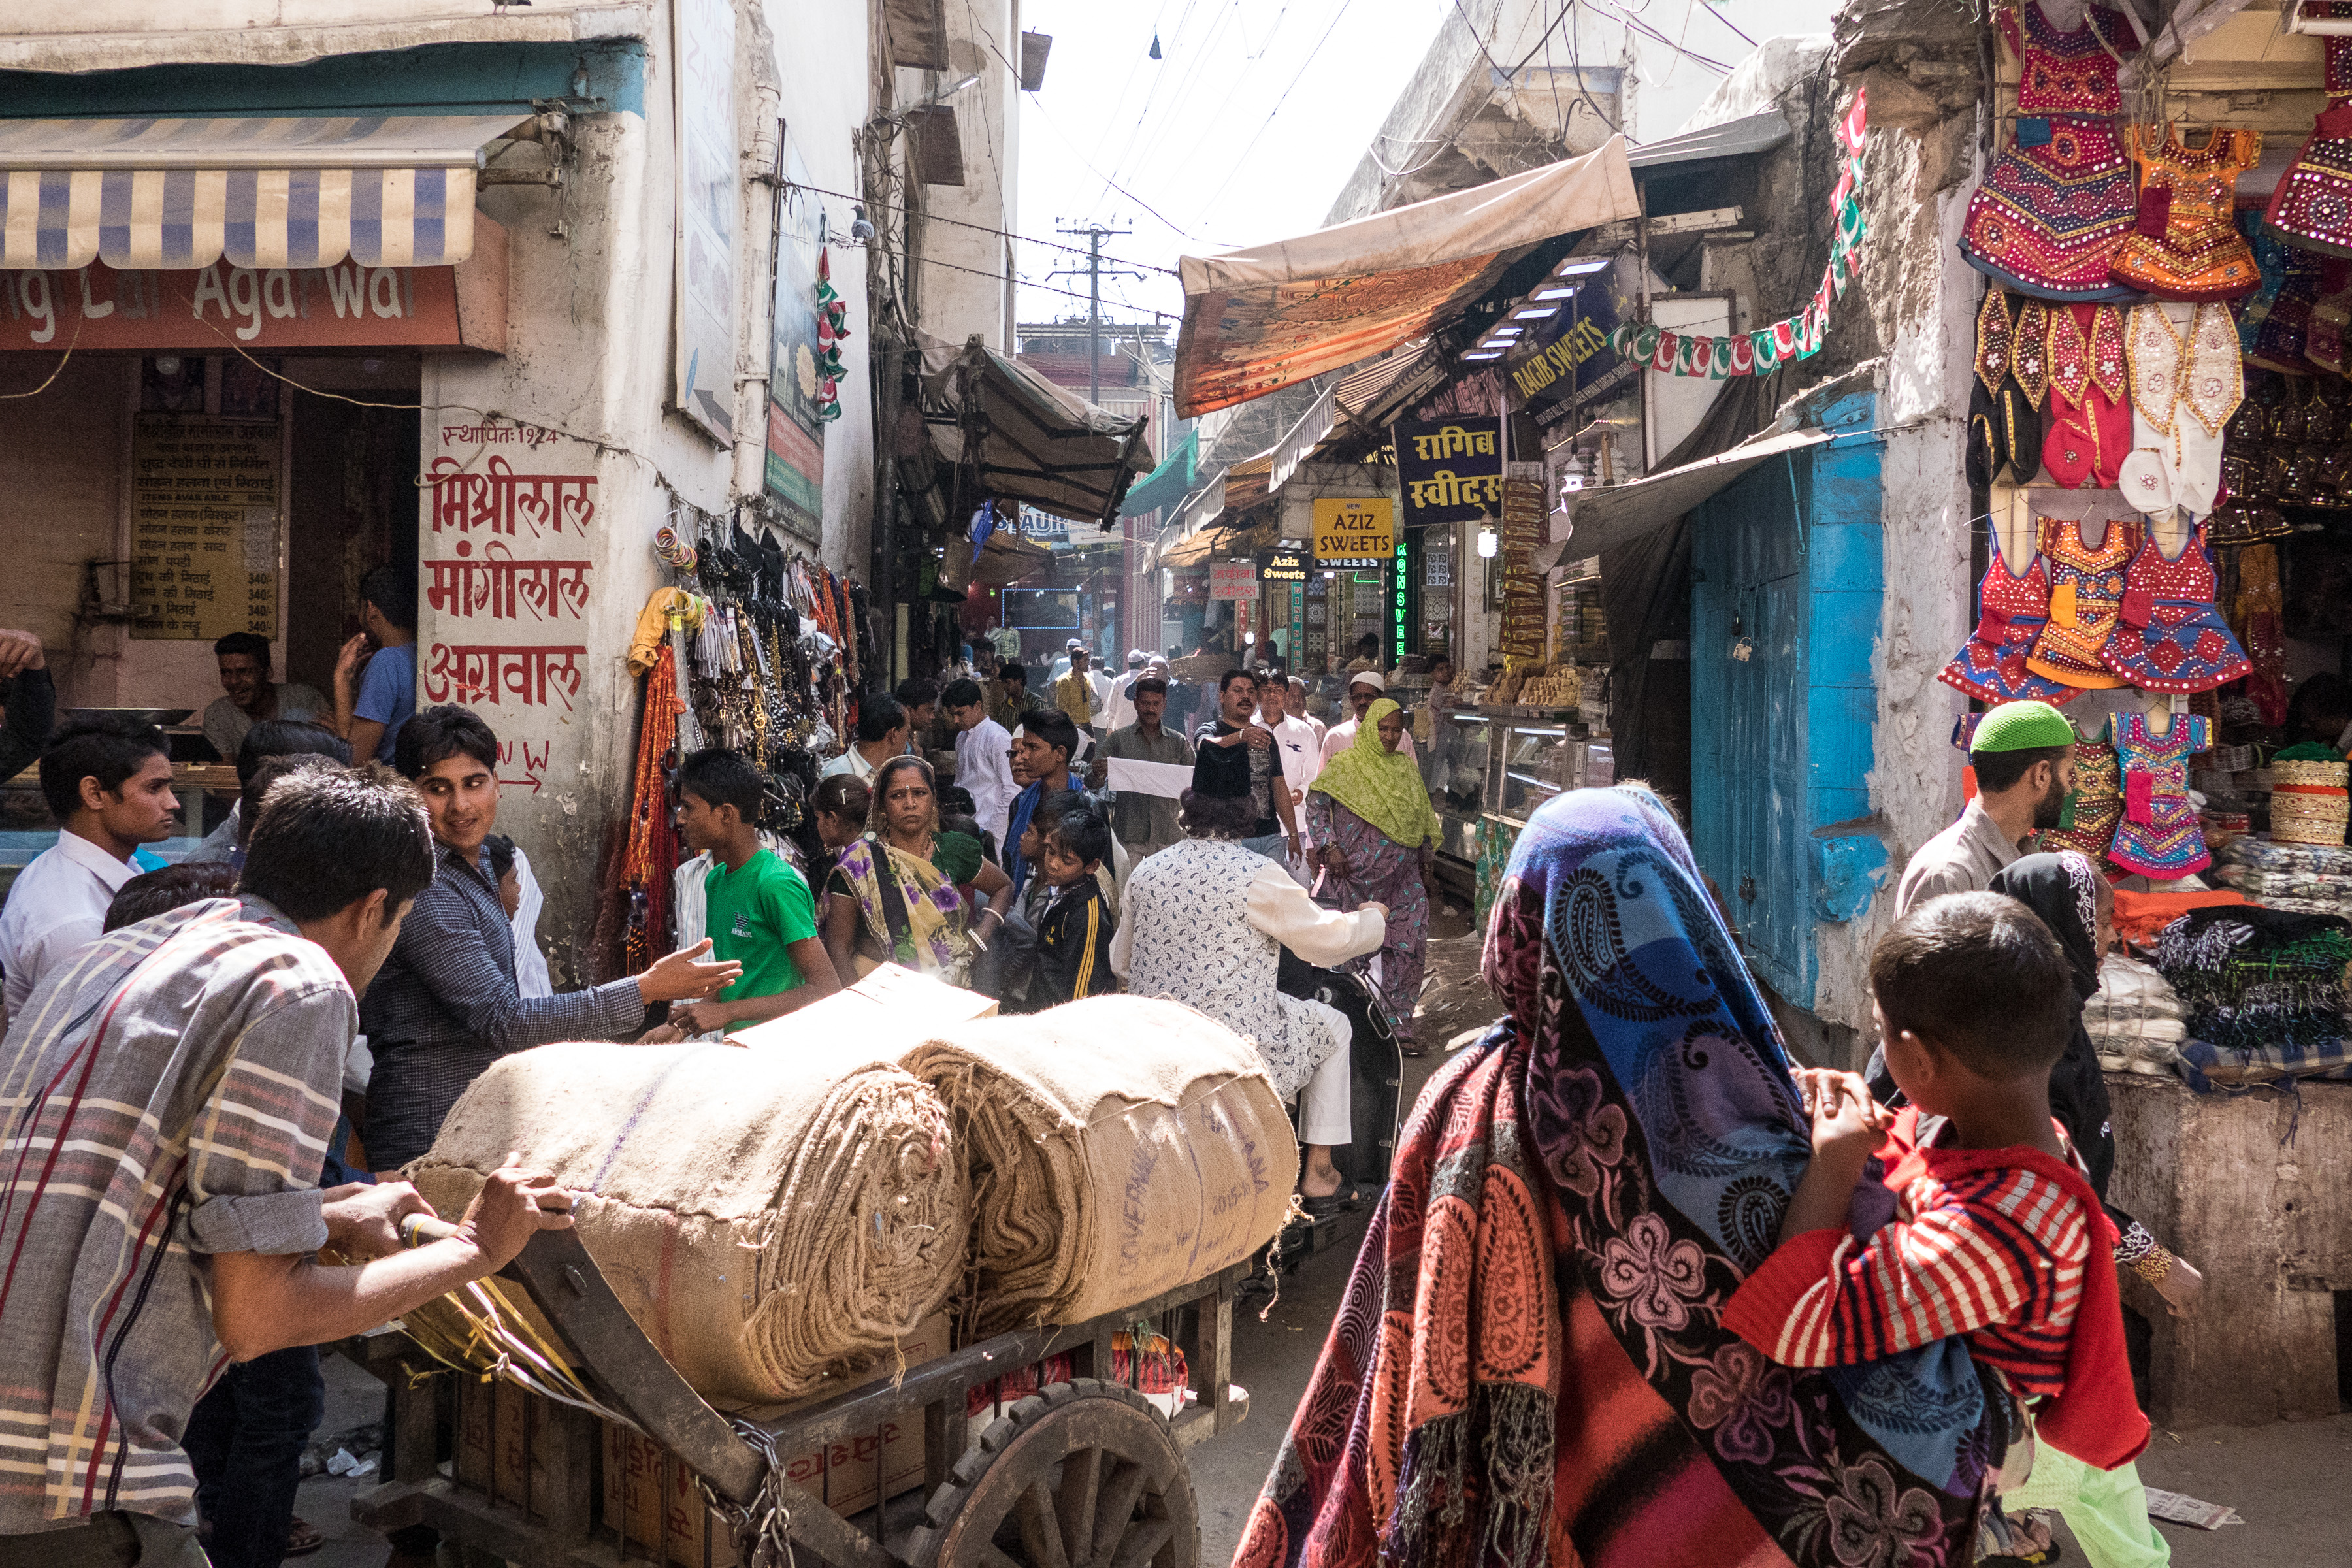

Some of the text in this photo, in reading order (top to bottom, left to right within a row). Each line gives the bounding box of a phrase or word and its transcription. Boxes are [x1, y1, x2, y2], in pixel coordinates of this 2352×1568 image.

[1512, 316, 1607, 399] RAGIB SWEETS
[1413, 426, 1495, 461] रागिब
[425, 456, 598, 538] मिश्रीलाल
[1333, 514, 1375, 530] AZIZ
[1271, 555, 1299, 566] Aziz
[1320, 535, 1389, 552] SWEETS
[423, 540, 593, 621] मांगीलाल
[1264, 568, 1305, 580] Sweets
[1396, 591, 1406, 663] SWEE
[424, 642, 587, 711] अग्रवाल
